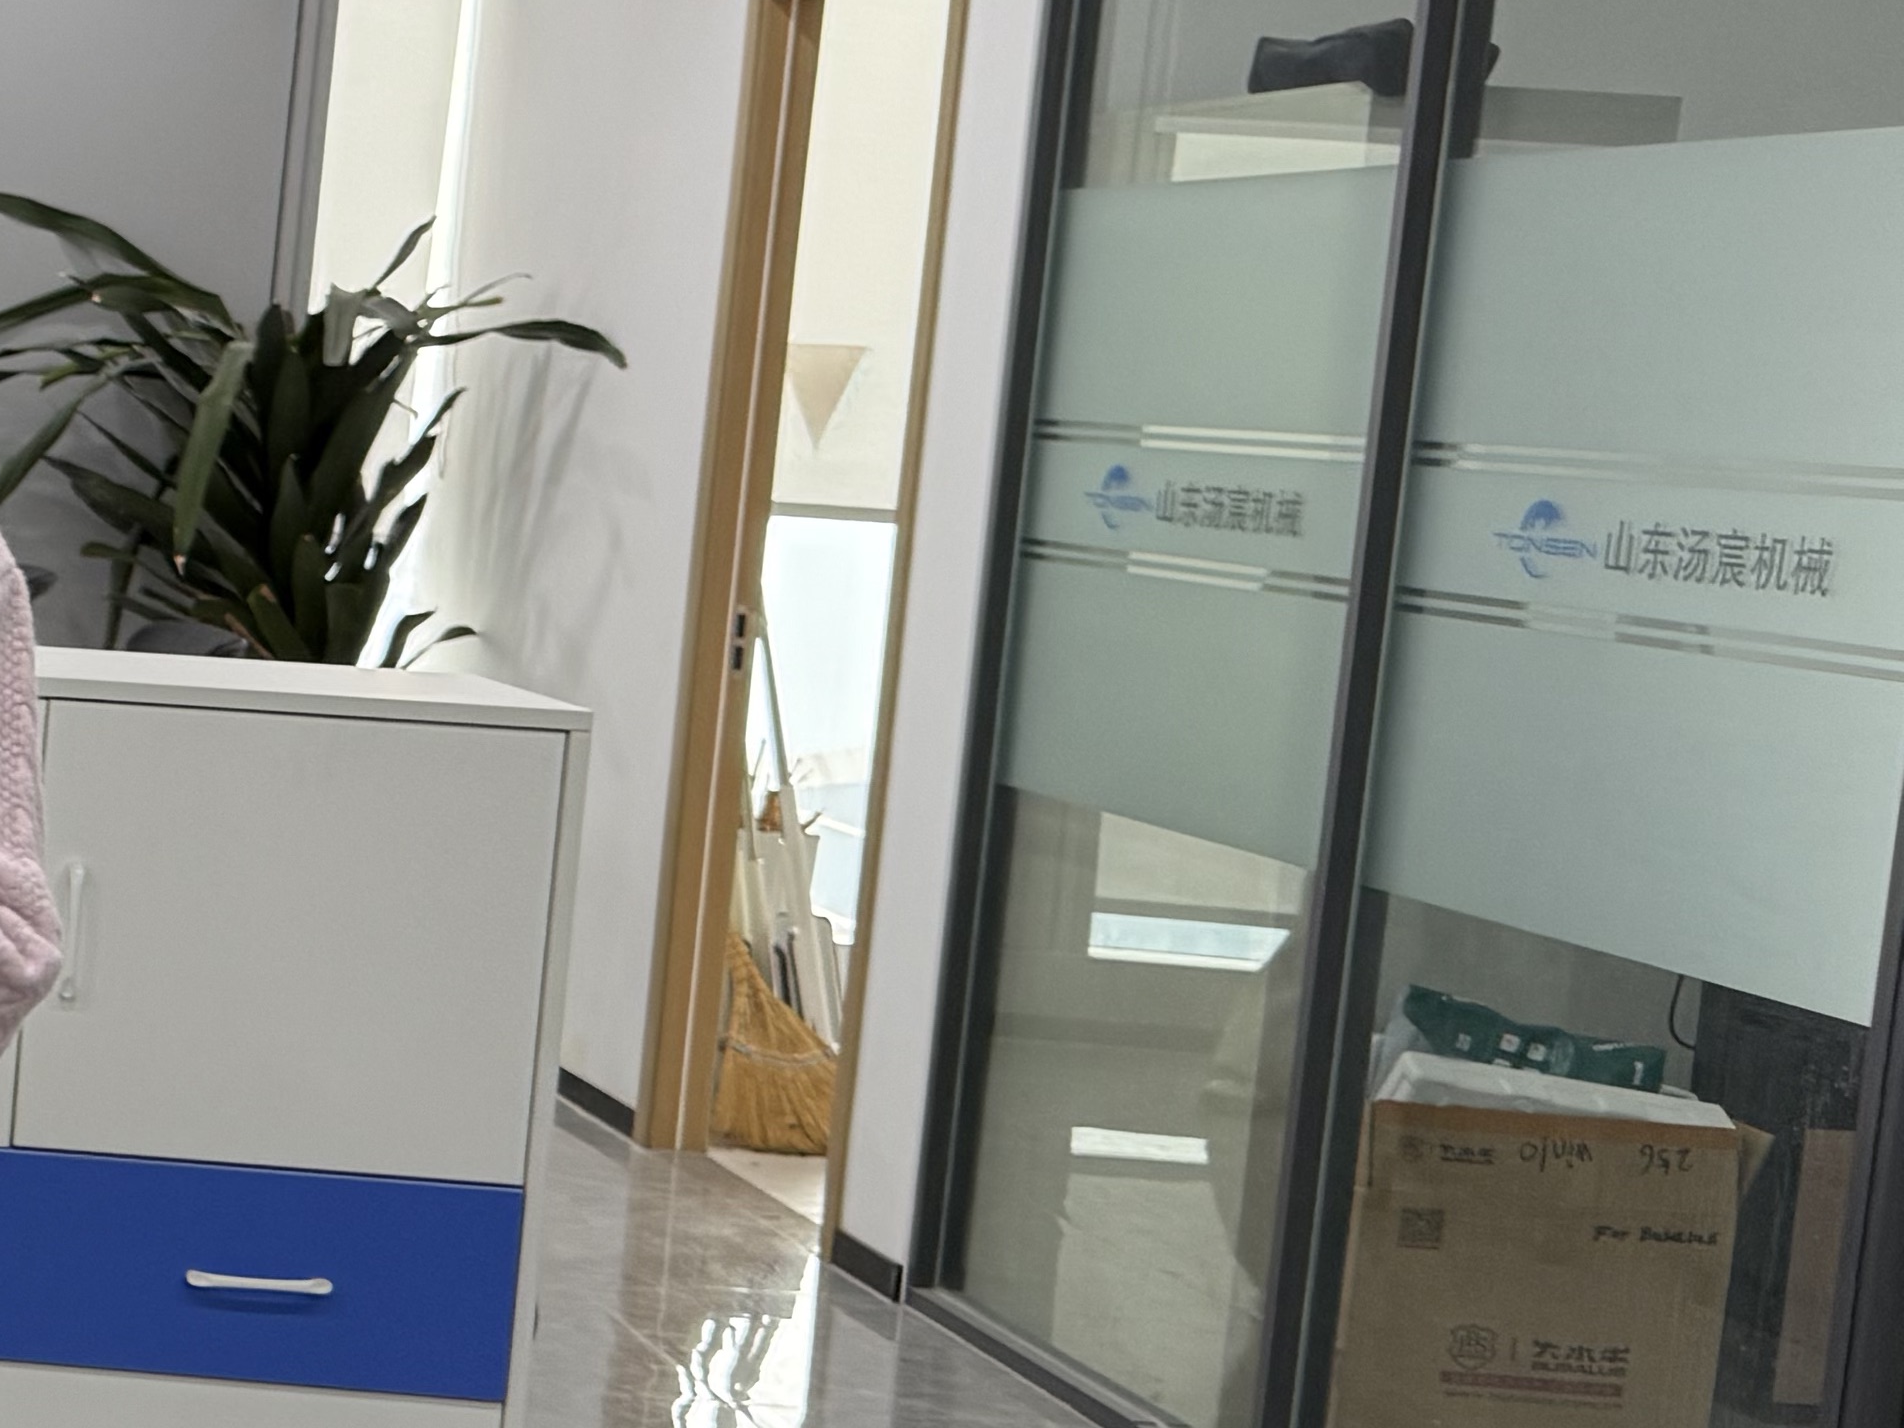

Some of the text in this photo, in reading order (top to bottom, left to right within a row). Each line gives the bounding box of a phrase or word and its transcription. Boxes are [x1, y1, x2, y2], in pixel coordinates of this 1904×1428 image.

[1603, 519, 1835, 597] 山东汤宸机械
